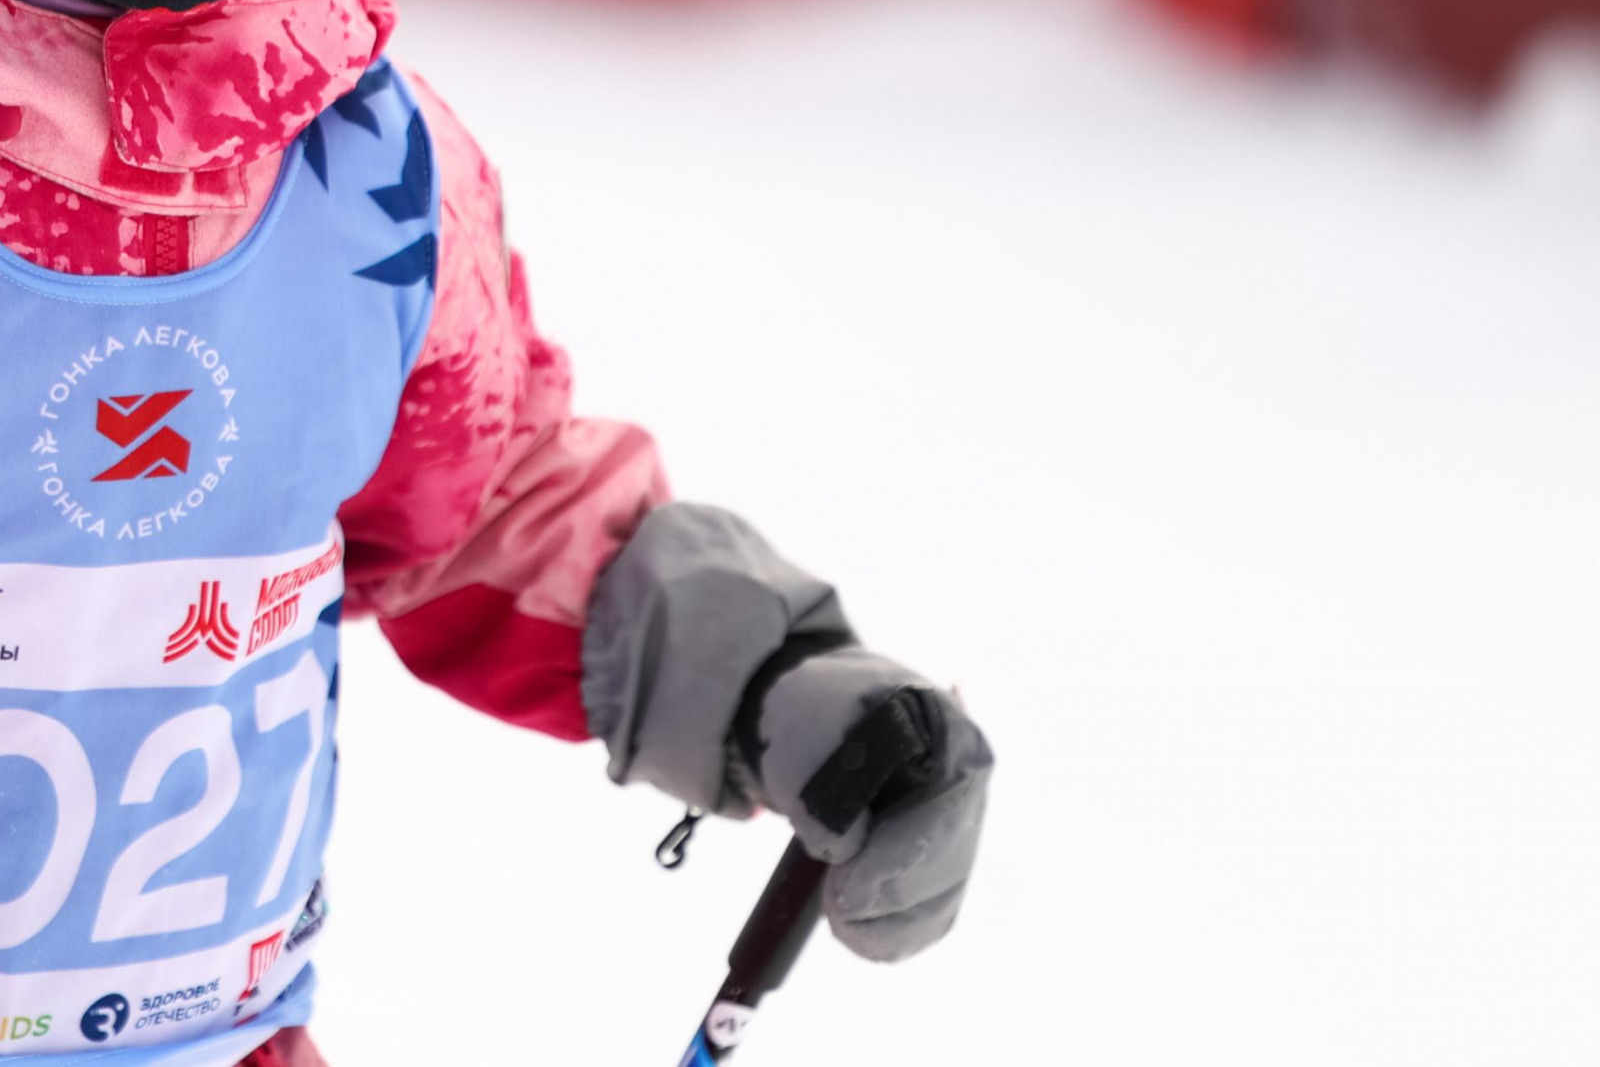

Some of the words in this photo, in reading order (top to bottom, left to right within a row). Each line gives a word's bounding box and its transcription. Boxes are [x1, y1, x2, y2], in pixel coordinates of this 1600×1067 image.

[40, 336, 125, 419] ГОНКА
[134, 325, 237, 408] ЛЕГКОВА
[37, 462, 106, 537] ГОНКА
[117, 455, 233, 540] ЛЕГКОВА
[135, 997, 221, 1029] ОТЕЧЕСТВО
[140, 977, 222, 1011] ЗДОРОВОЕ
